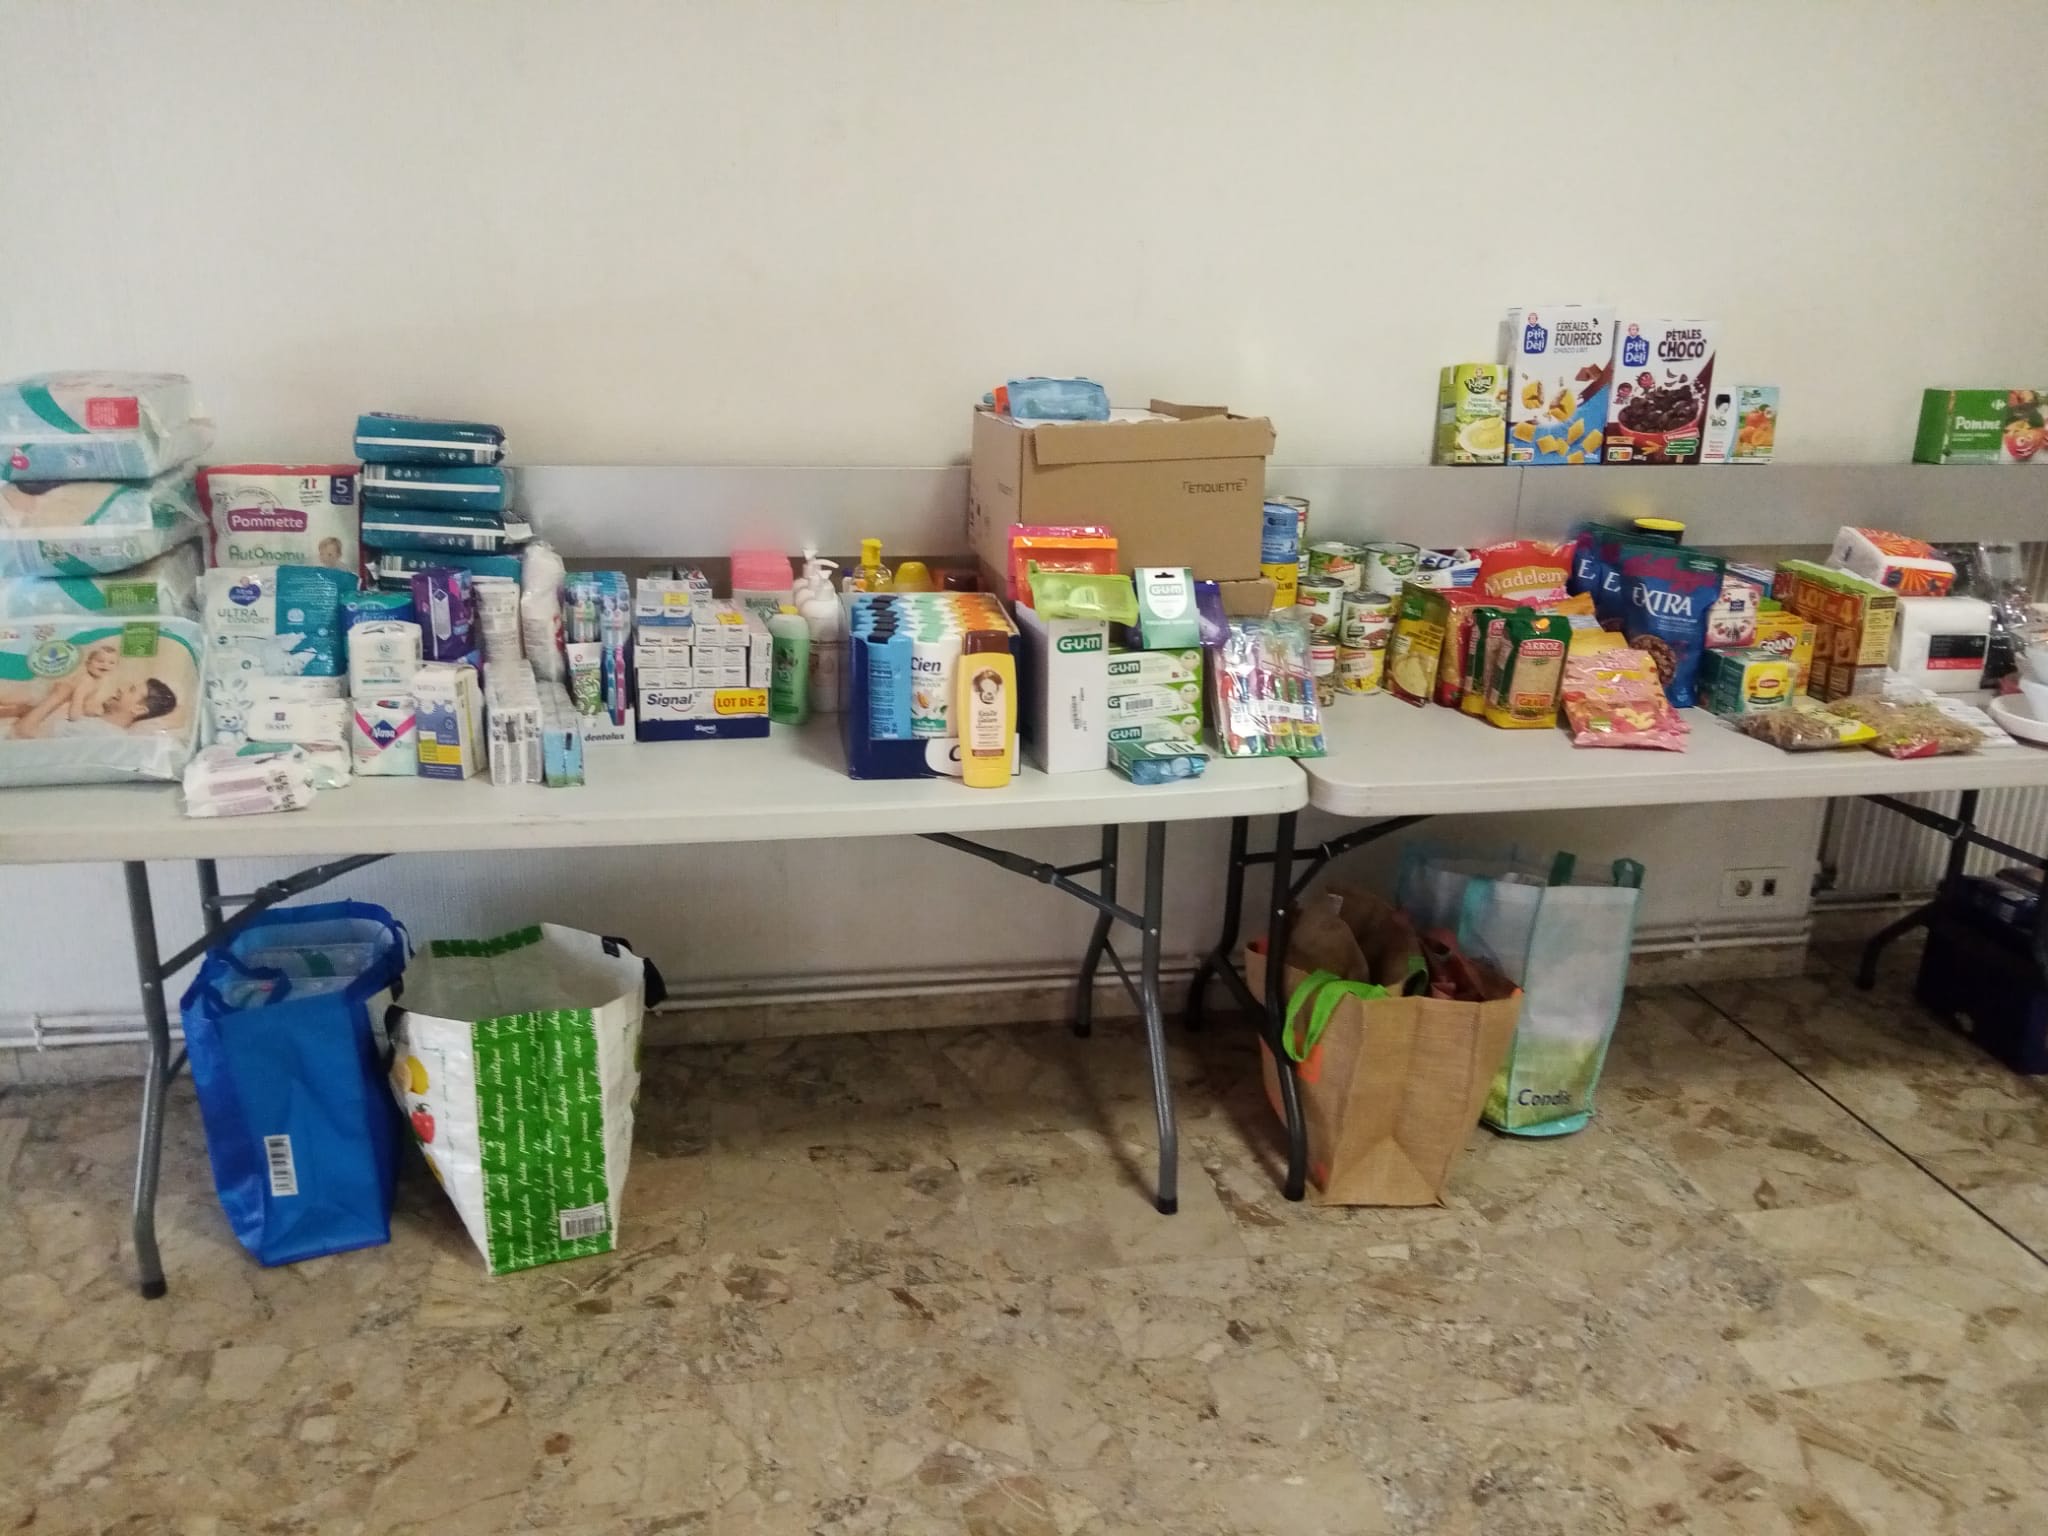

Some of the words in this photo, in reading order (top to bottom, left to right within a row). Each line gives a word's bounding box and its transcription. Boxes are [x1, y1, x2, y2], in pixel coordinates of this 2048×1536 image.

[336, 479, 348, 494] 5
[1188, 482, 1244, 494] ETIQUETTE
[231, 514, 304, 529] Pommette
[1632, 582, 1691, 617] EXTRA
[217, 608, 258, 617] ULTRA
[911, 657, 941, 673] Cien
[647, 693, 692, 708] Signal
[717, 697, 736, 708] LOT
[739, 697, 754, 707] DE
[758, 695, 766, 706] 2
[1517, 1088, 1571, 1107] Condis
